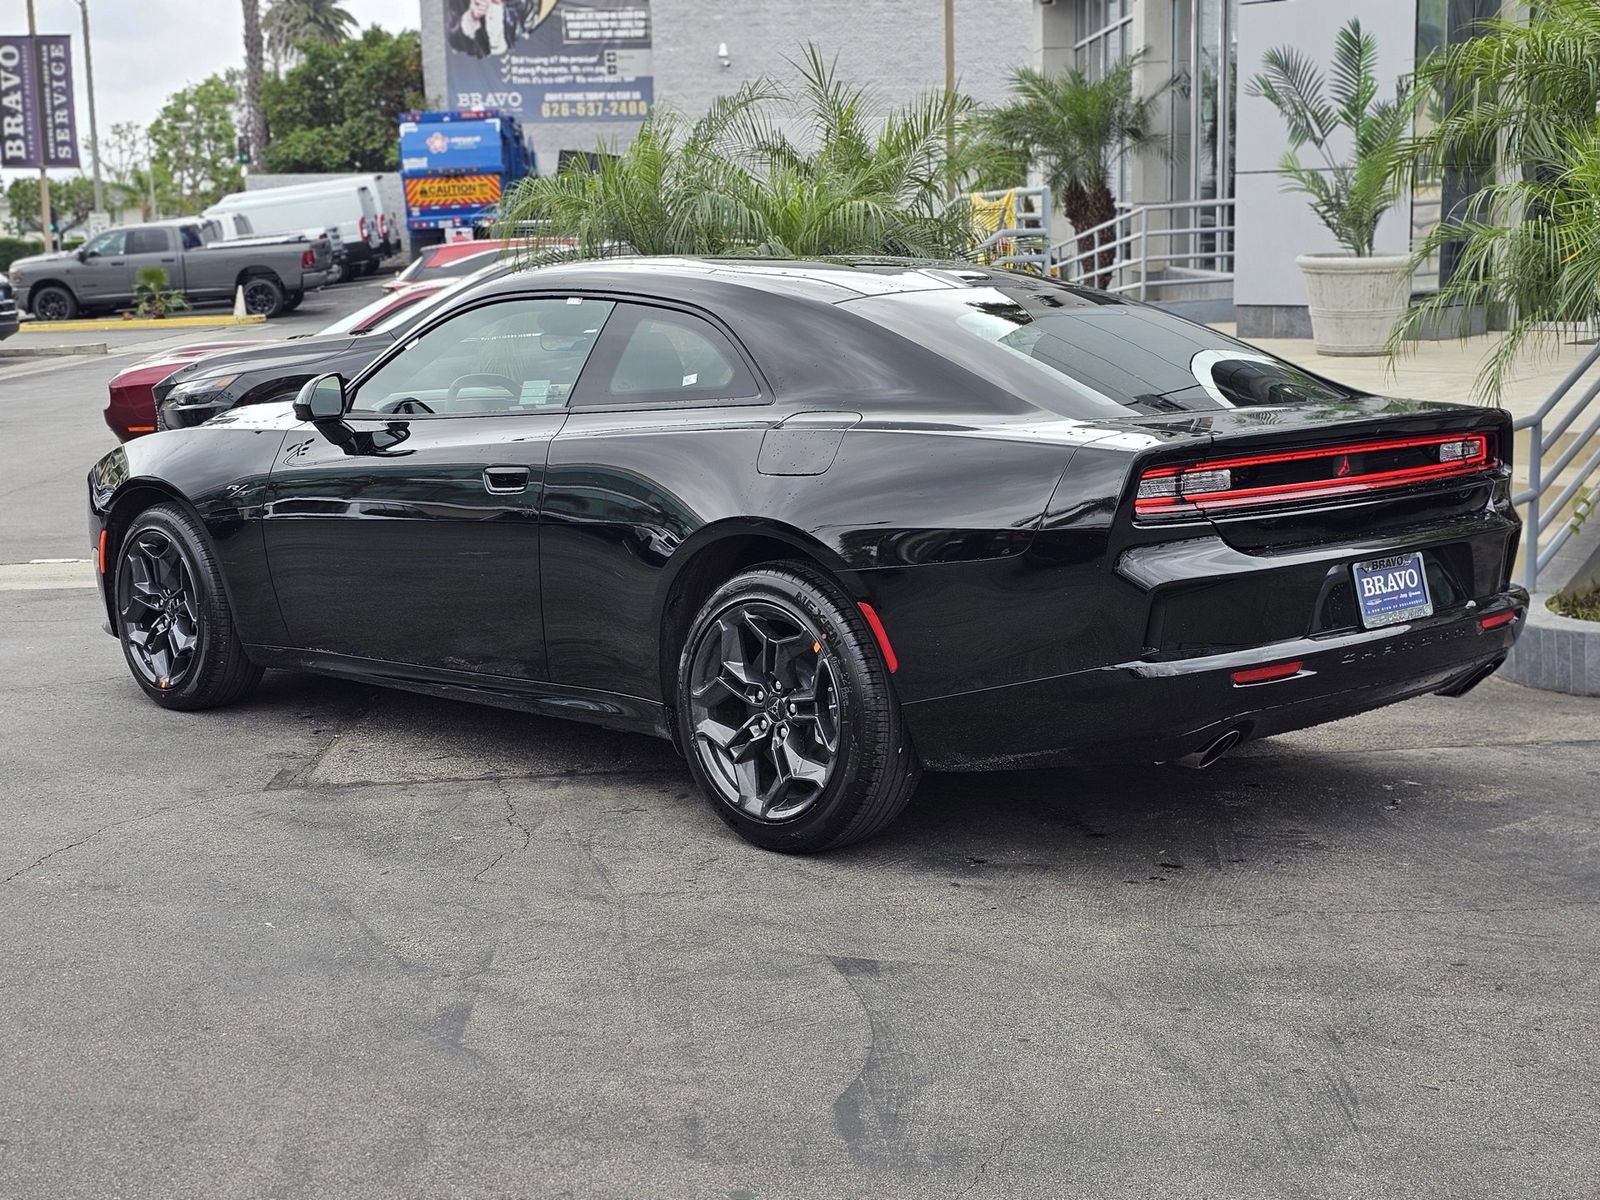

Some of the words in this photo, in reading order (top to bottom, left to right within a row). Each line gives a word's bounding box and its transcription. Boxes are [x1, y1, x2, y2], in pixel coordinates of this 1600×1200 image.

[0, 44, 26, 160] BRAVO
[50, 44, 72, 159] SERVICE
[457, 92, 522, 107] BRAVO
[541, 100, 647, 118] 626-537-2400
[428, 183, 476, 195] CAUTION
[1371, 556, 1404, 571] BRAVO
[1361, 568, 1418, 597] BRAVO
[794, 591, 843, 648] NEXEN
